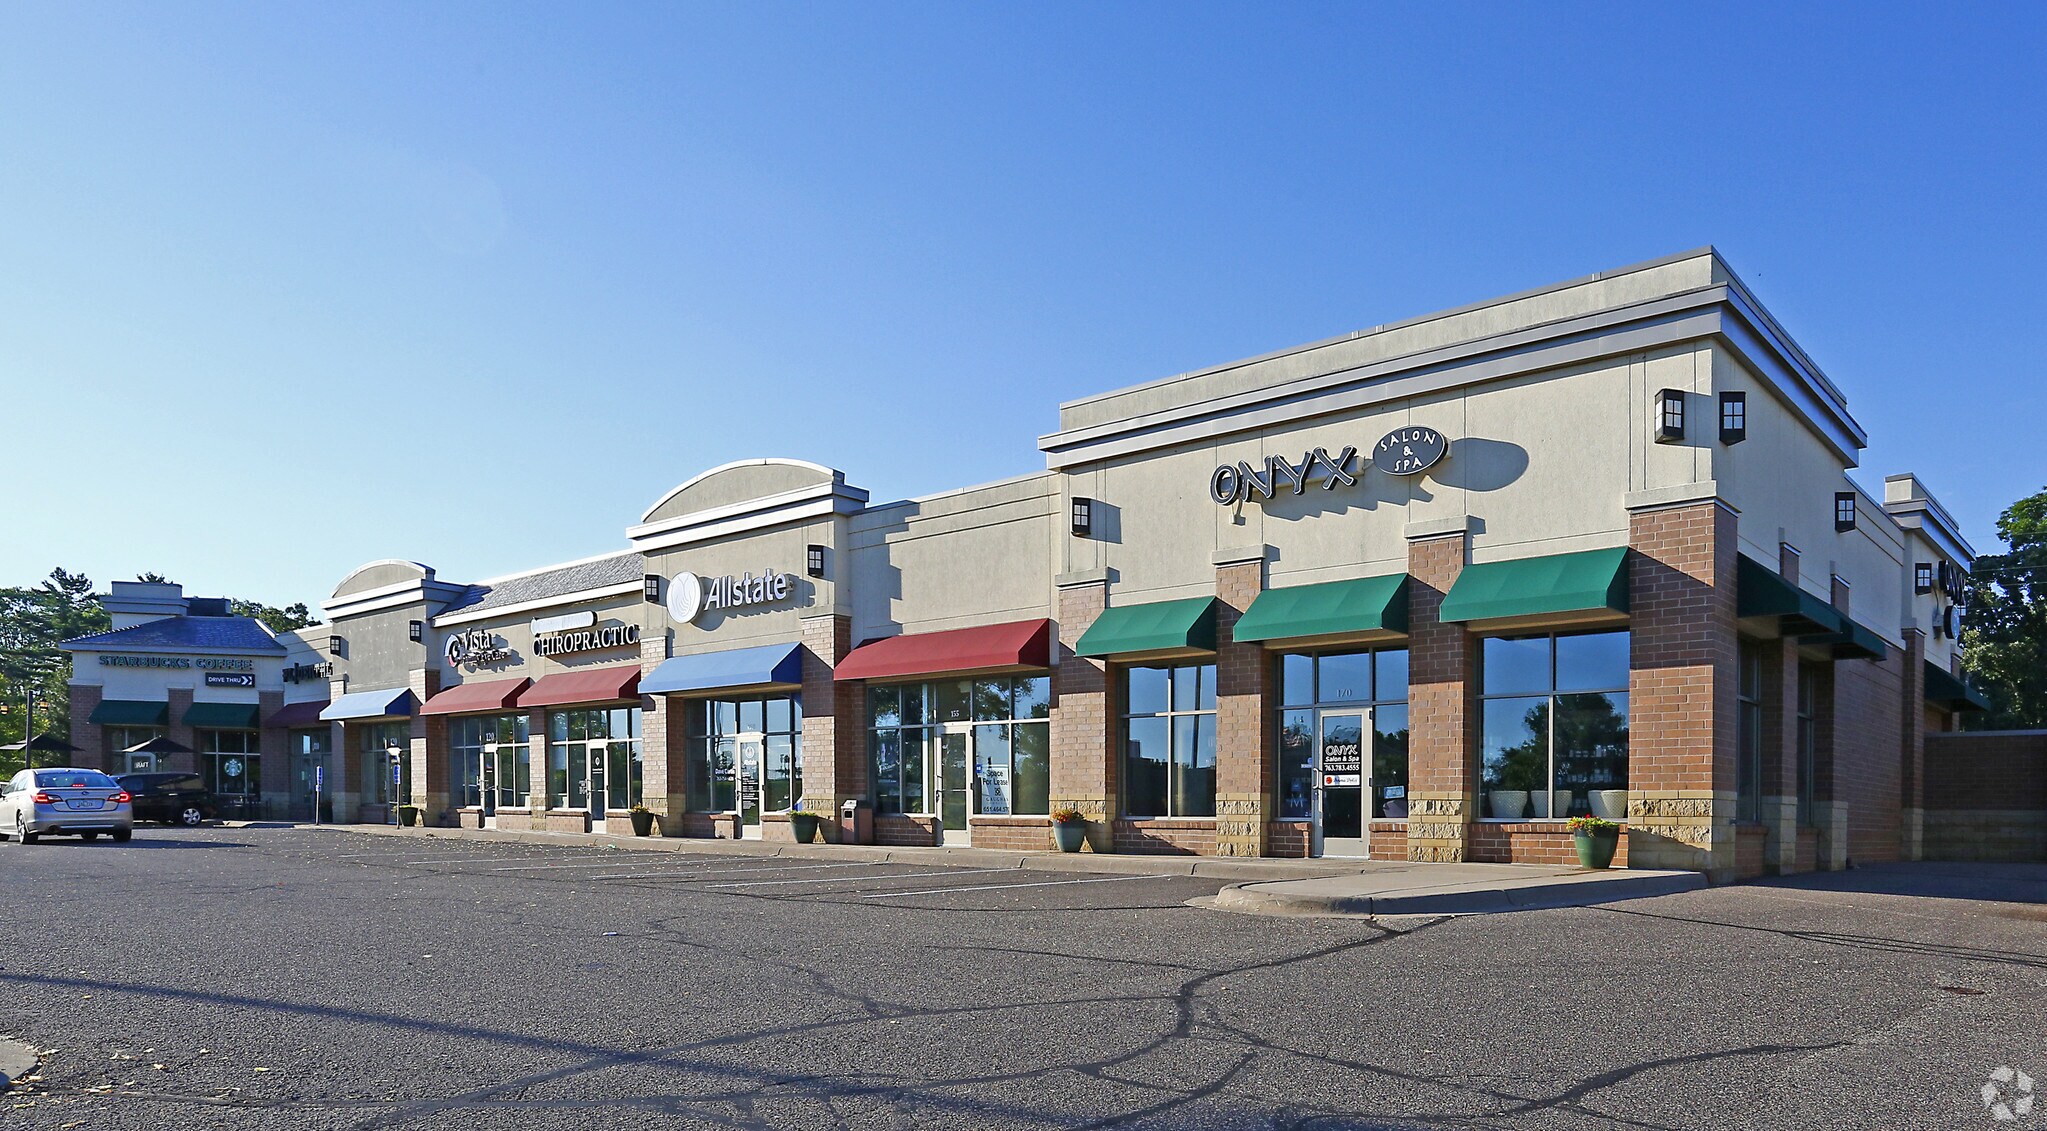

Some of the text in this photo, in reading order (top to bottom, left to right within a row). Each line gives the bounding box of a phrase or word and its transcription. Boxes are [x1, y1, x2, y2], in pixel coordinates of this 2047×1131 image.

[1380, 430, 1437, 452] SALON
[1403, 445, 1414, 457] &
[1394, 459, 1424, 472] SPA
[1210, 444, 1357, 505] ONYX
[703, 568, 787, 611] Allstate
[462, 627, 492, 650] Vista
[99, 655, 253, 671] STARBUCKS COFFEE
[1325, 744, 1358, 756] ONYX
[1348, 755, 1360, 763] Spa
[986, 769, 1004, 778] Space
[1324, 764, 1360, 772] 763.783.4555
[982, 777, 1008, 786] For Lease
